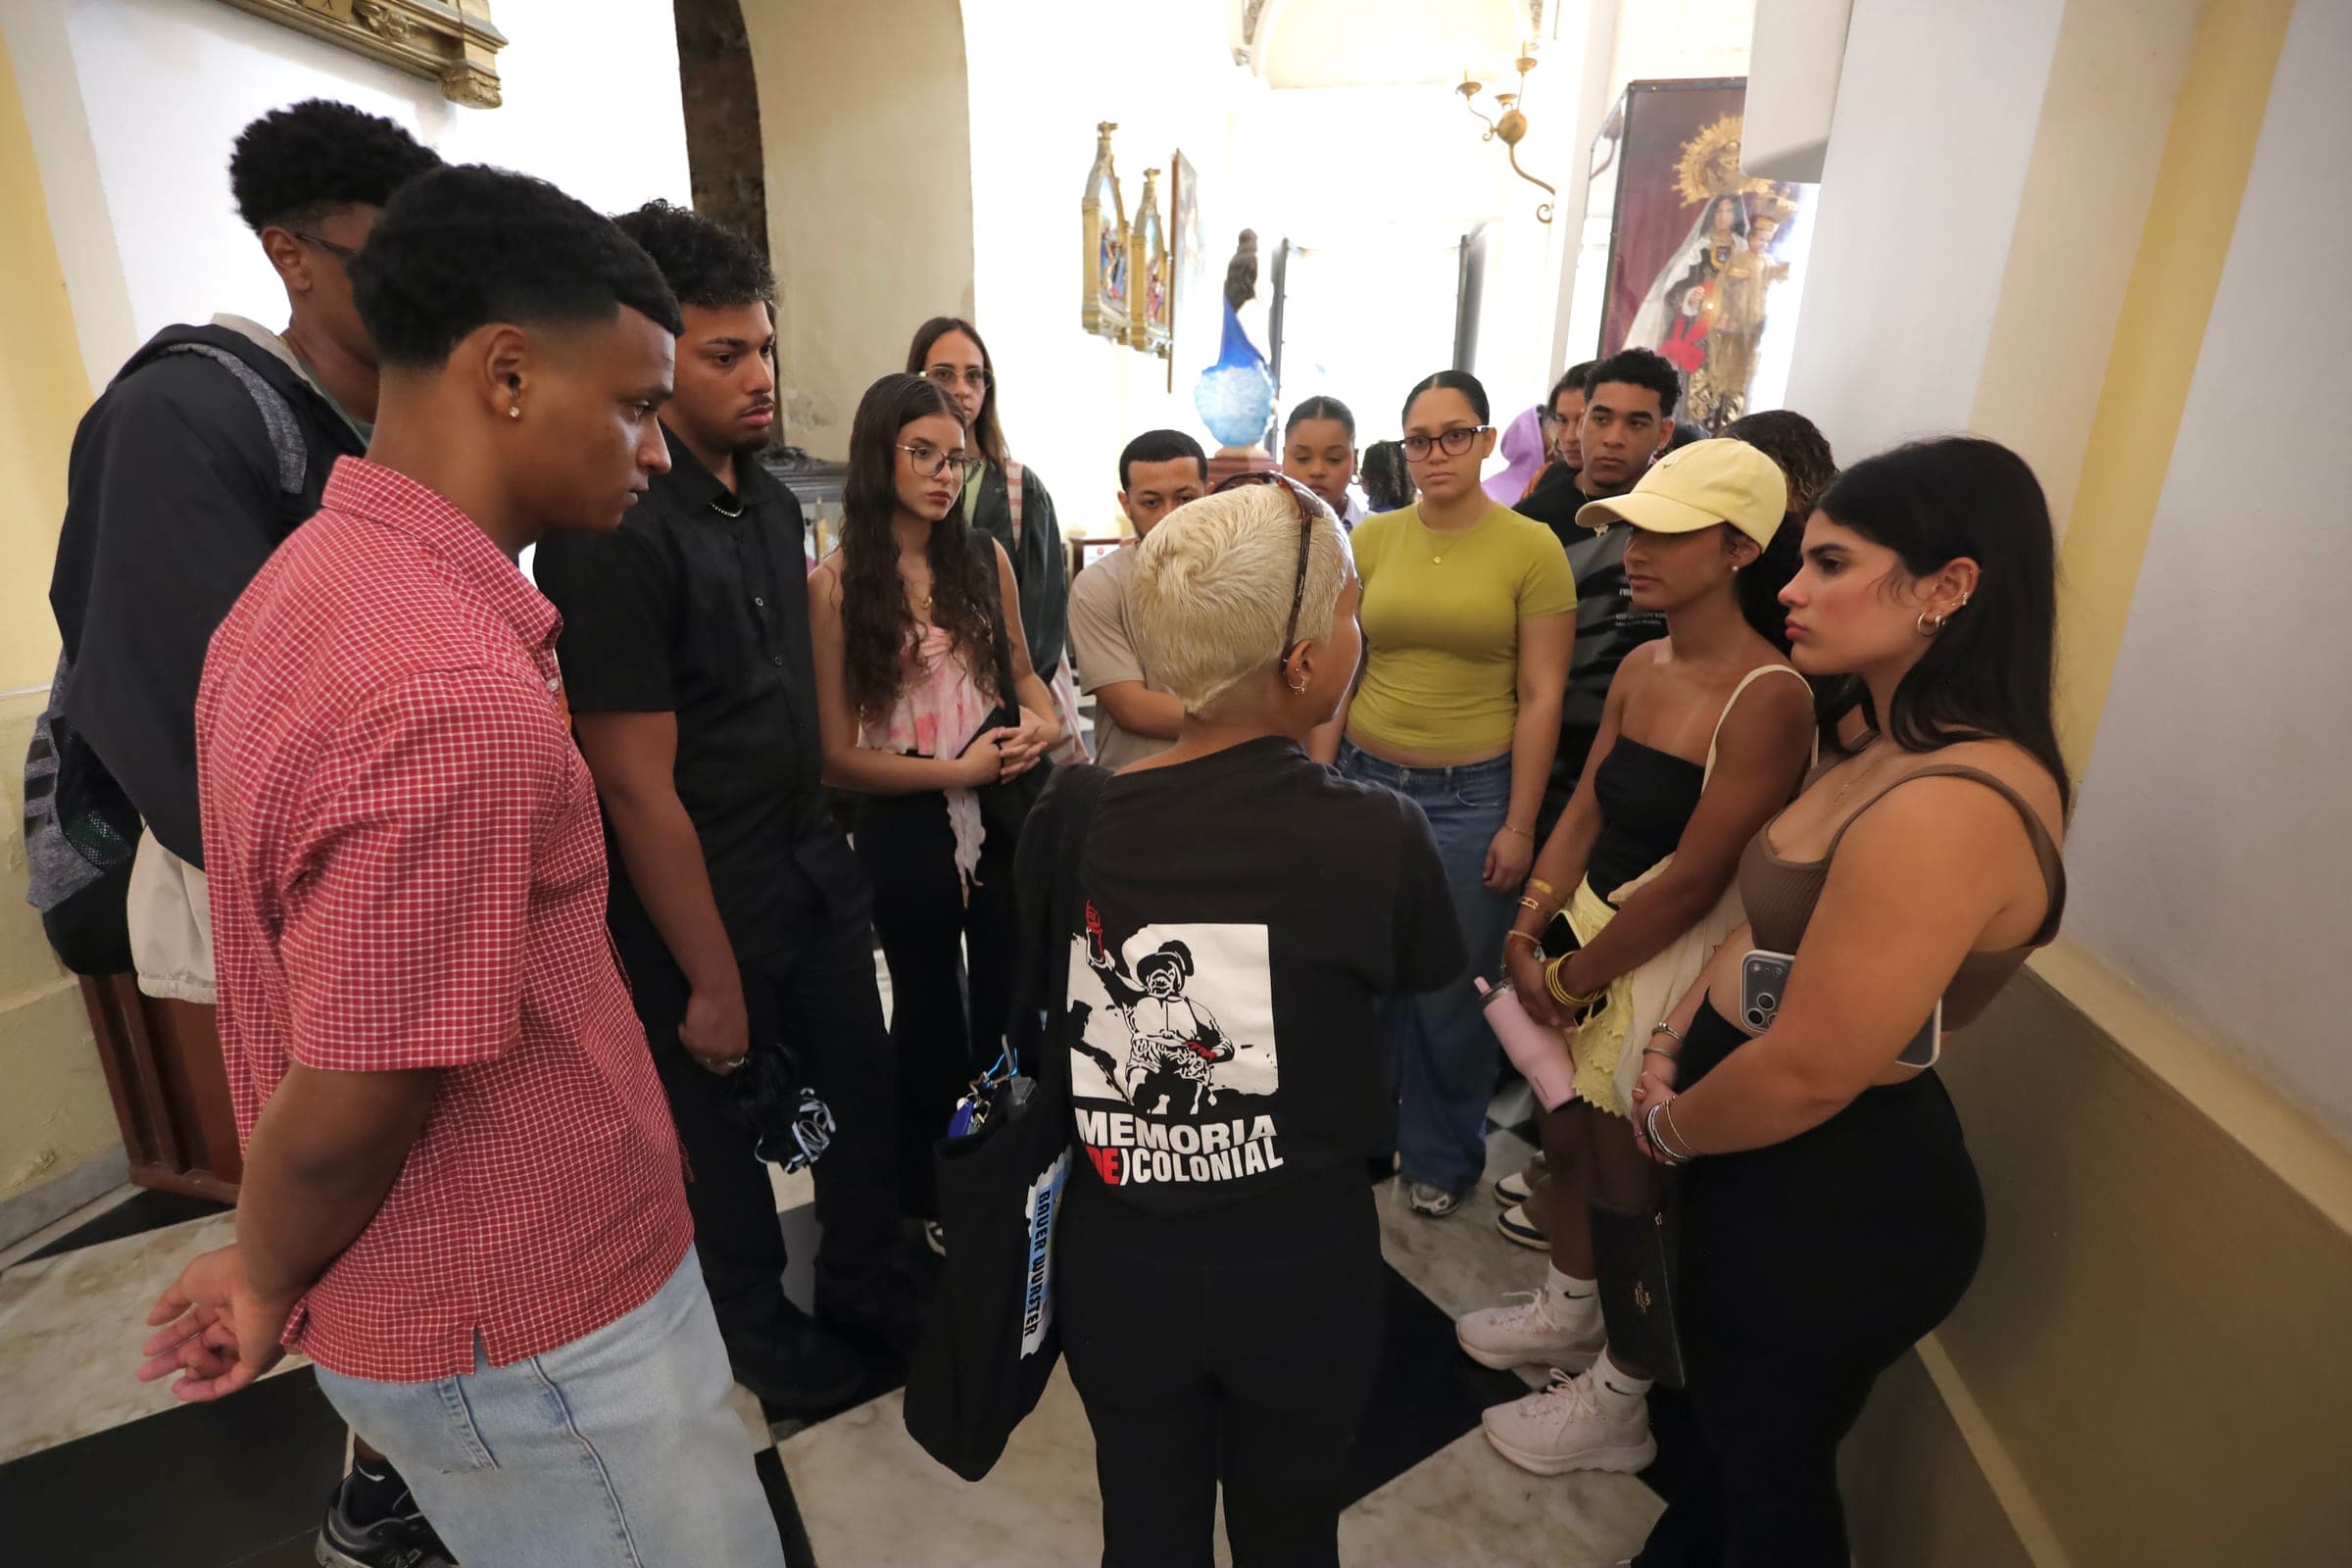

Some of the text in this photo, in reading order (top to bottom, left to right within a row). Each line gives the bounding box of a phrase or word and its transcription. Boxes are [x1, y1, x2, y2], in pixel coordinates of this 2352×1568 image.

[1074, 1107, 1278, 1155] MEMORIA
[1024, 1190, 1051, 1338] BAUER WURSTER
